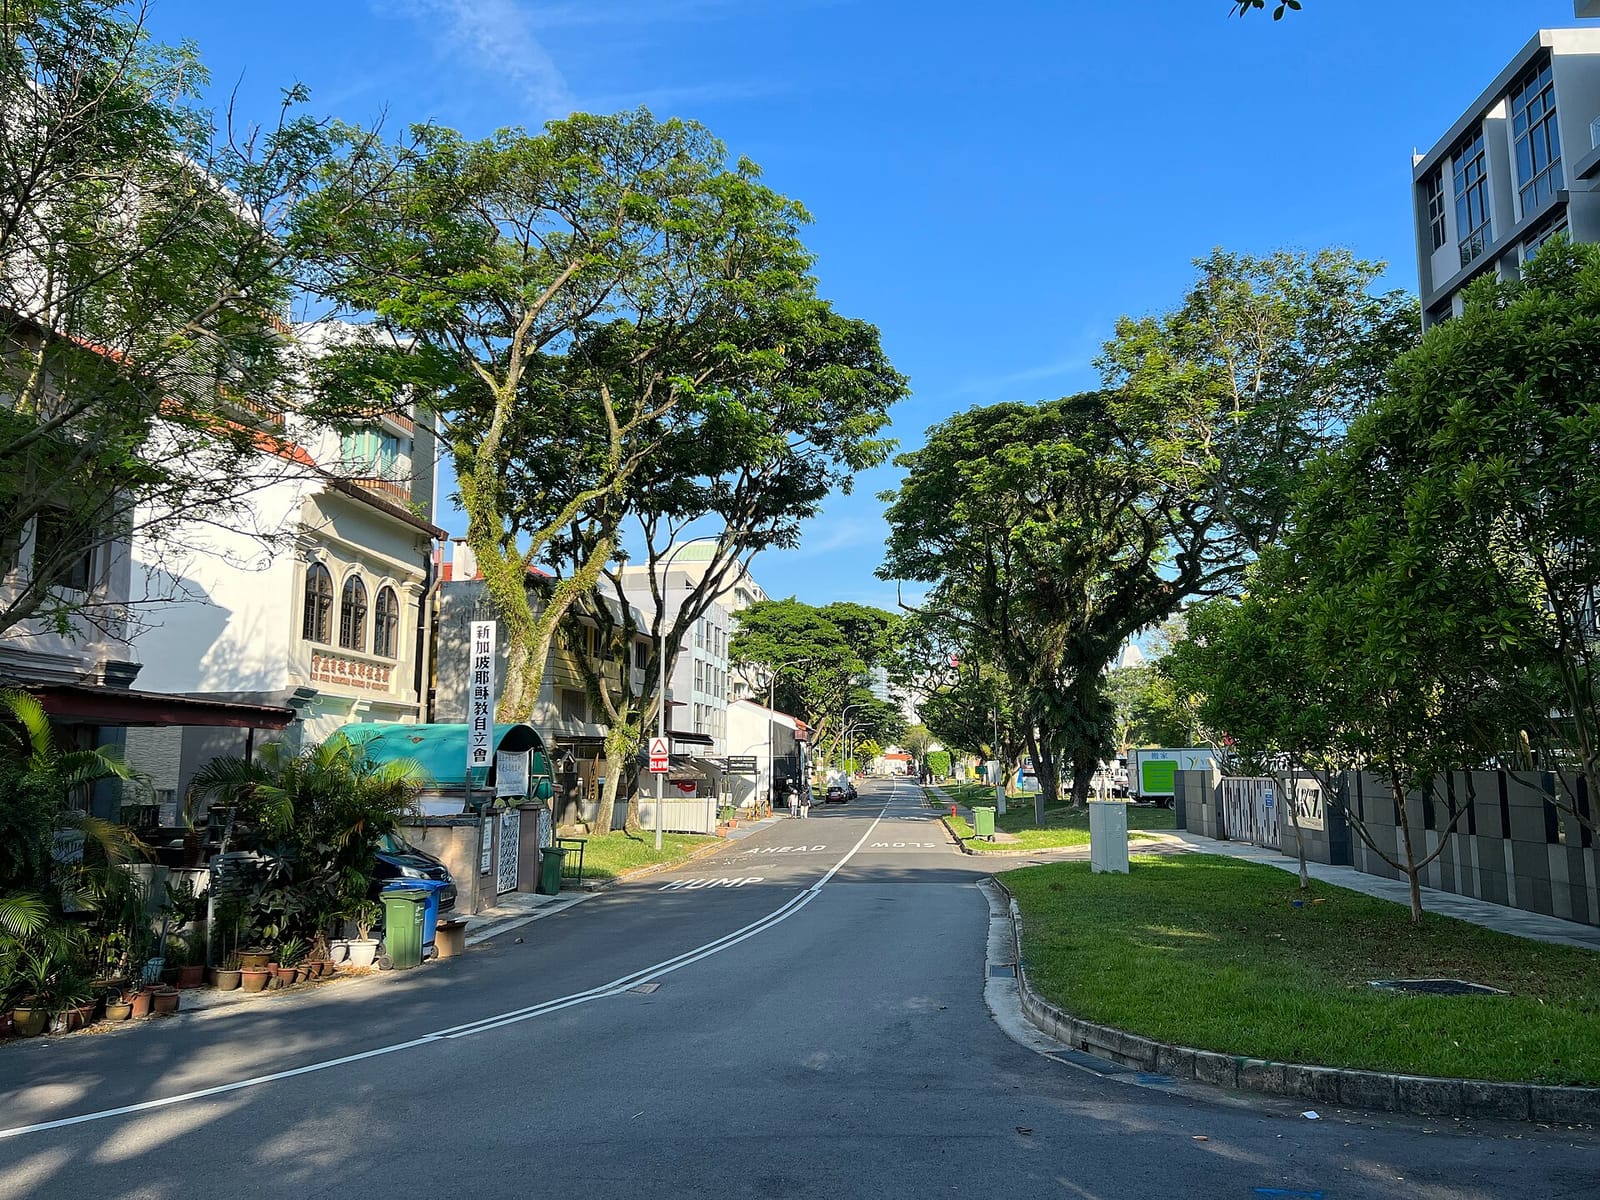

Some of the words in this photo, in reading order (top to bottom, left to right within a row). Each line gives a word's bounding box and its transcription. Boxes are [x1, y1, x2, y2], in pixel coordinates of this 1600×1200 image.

[650, 761, 668, 769] SLOW
[746, 845, 827, 855] AHEAD
[658, 876, 765, 891] HUMP
